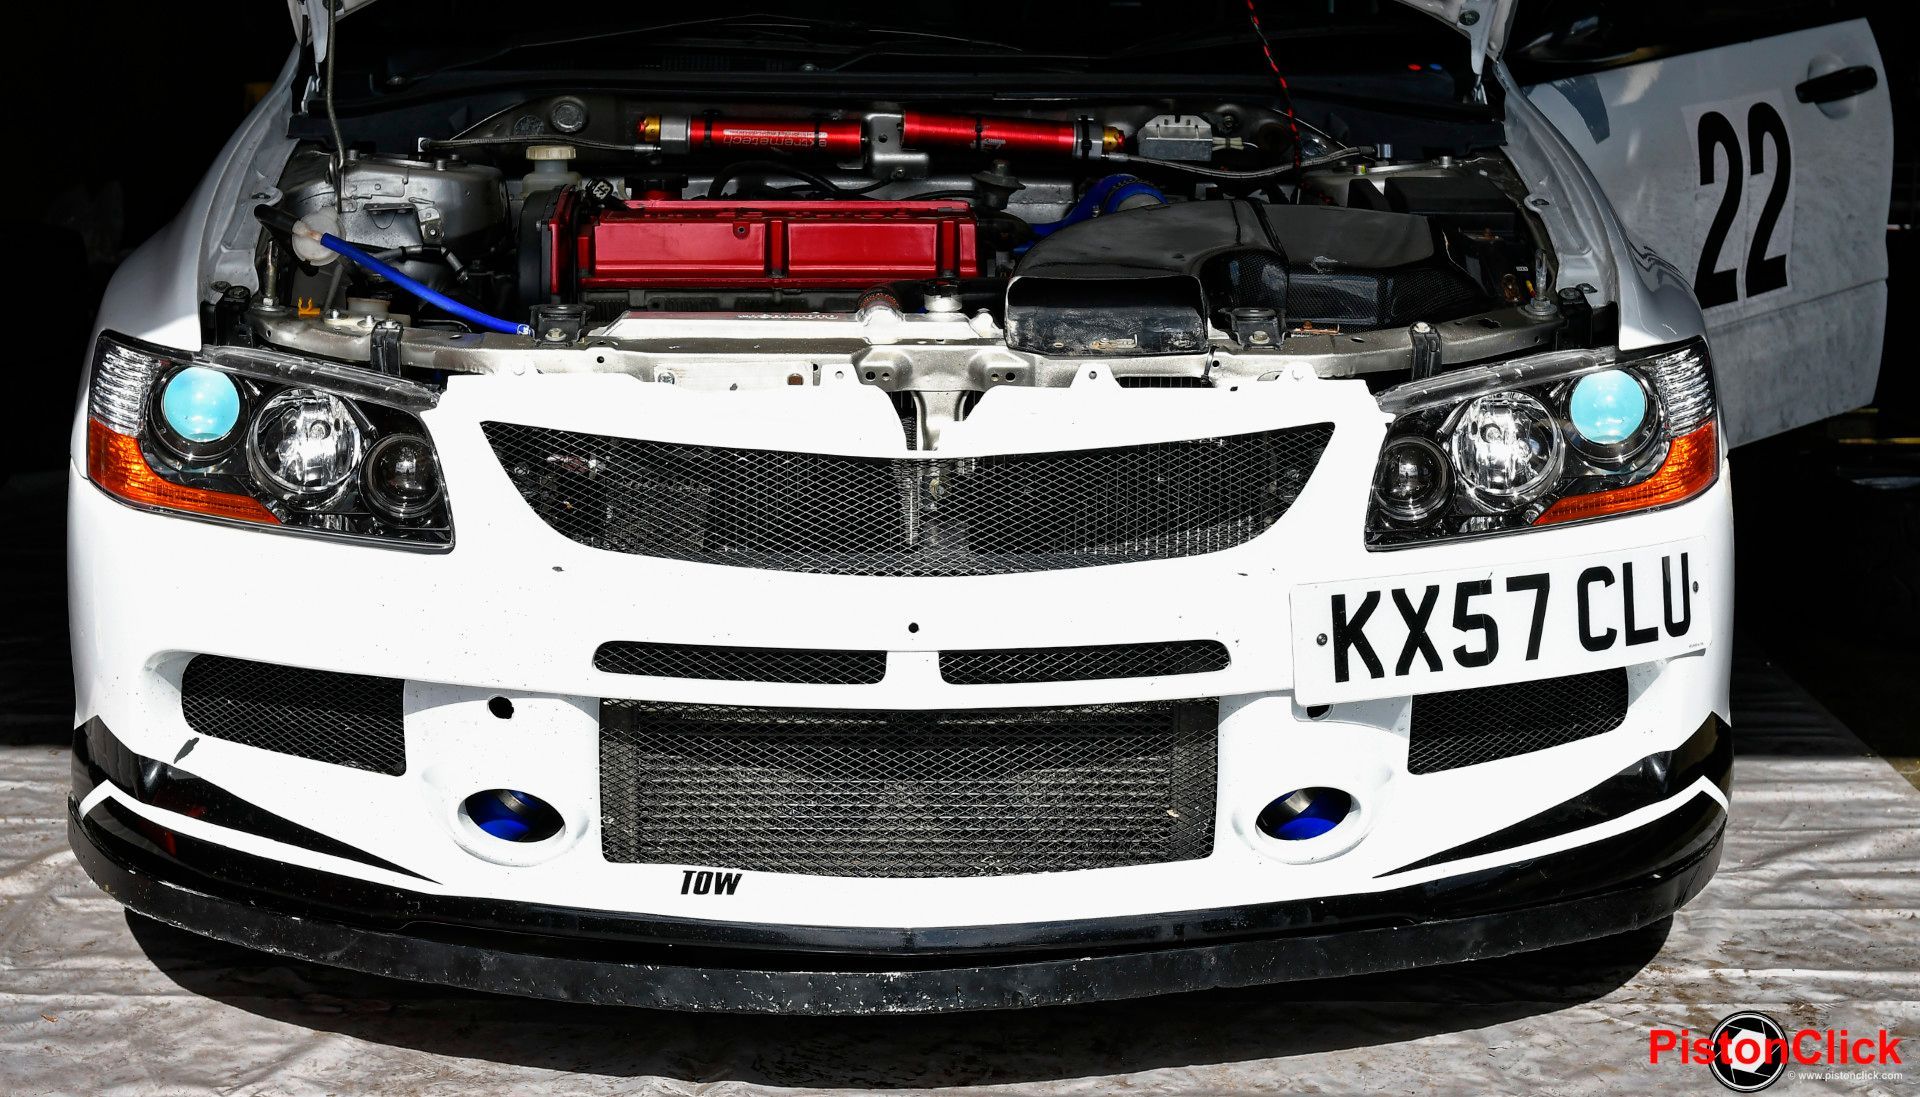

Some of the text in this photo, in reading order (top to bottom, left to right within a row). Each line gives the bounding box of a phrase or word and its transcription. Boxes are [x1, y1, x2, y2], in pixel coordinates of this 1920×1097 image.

[1692, 101, 1792, 311] 22
[1331, 552, 1691, 683] KX57 CLU
[680, 870, 743, 896] TOW
